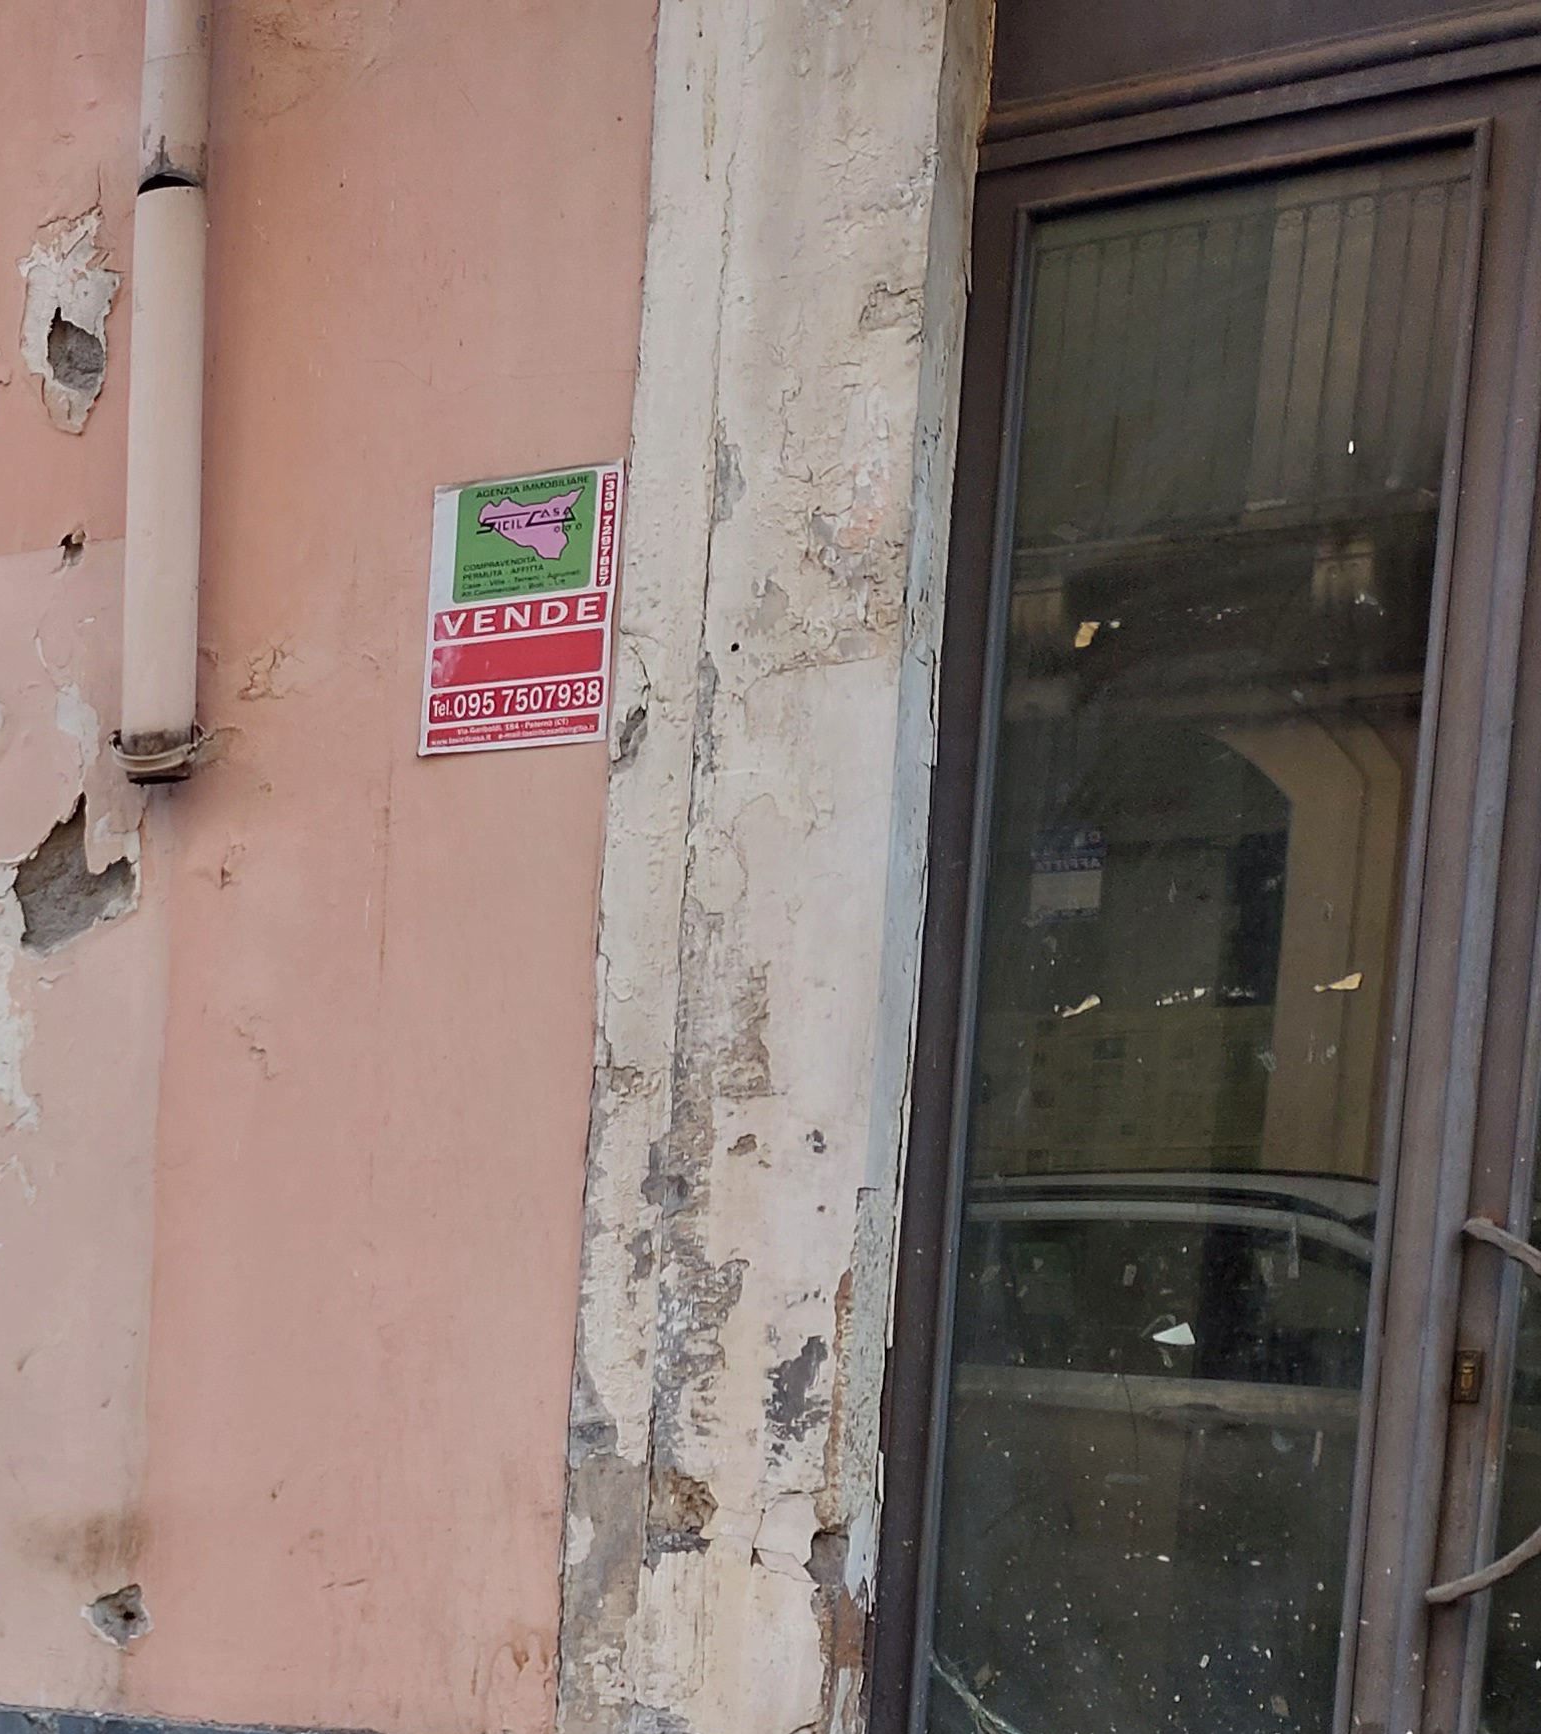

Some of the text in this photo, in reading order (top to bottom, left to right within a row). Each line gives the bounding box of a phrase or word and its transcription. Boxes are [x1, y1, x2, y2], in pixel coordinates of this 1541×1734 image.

[476, 486, 520, 498] AGENZIA
[522, 475, 589, 492] IMMOBILIARE
[442, 596, 601, 636] VENDE
[432, 680, 601, 718] Tel. 095 7507938
